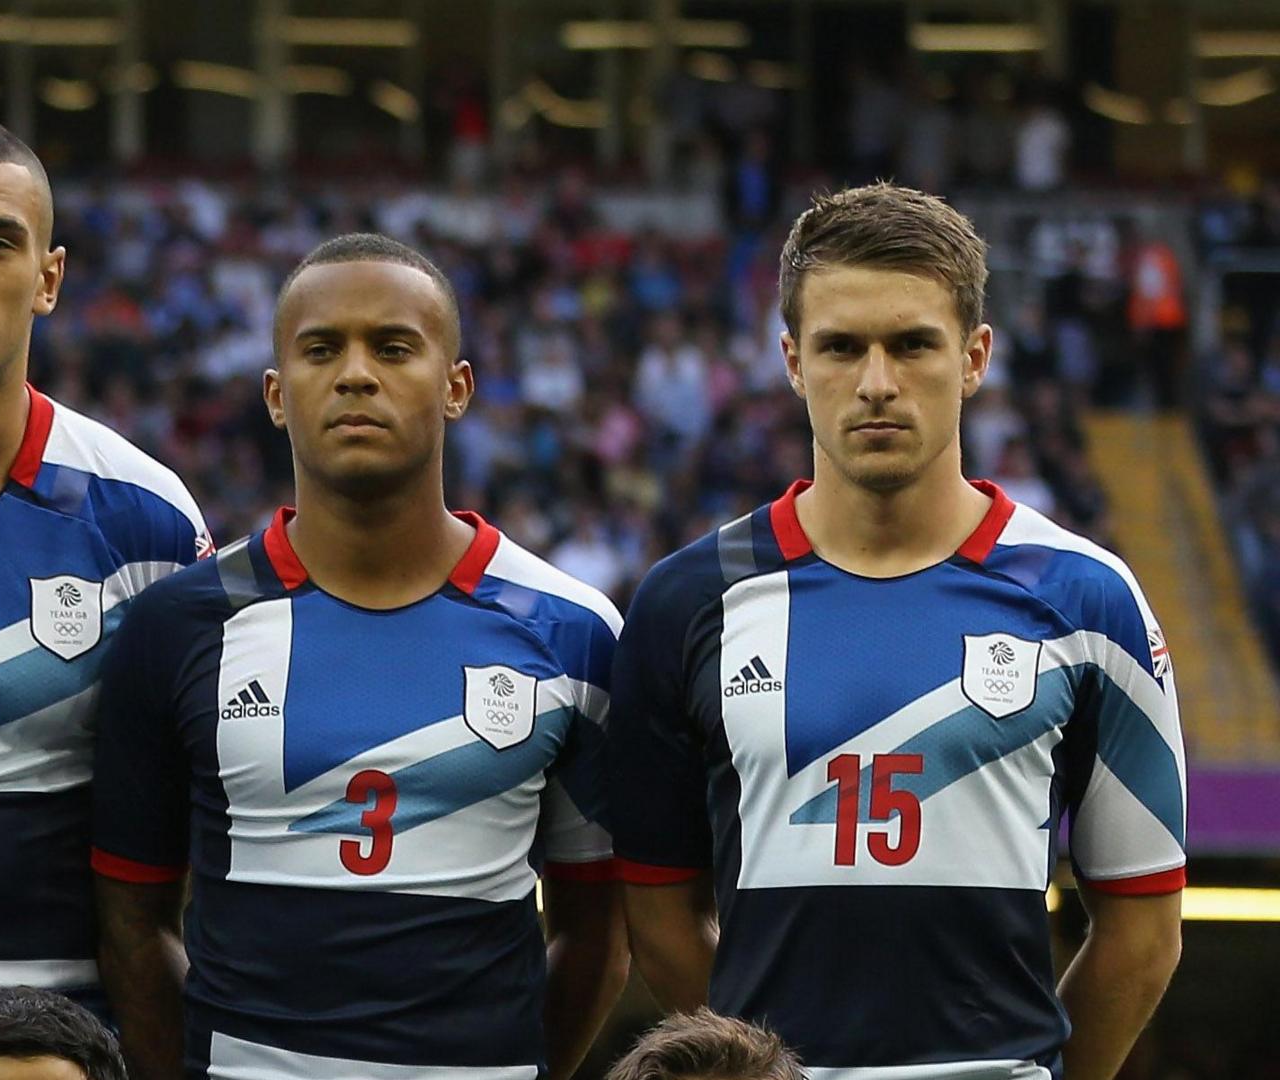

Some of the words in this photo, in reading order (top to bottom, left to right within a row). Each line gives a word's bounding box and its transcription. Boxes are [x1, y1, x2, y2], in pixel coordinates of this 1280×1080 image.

[50, 610, 73, 619] TEAM
[75, 611, 87, 619] GB
[982, 668, 1005, 676] TEAM
[1007, 670, 1019, 678] GB
[724, 680, 782, 697] adidas
[222, 705, 280, 719] adidas
[483, 699, 505, 708] TEAM
[508, 702, 519, 711] GB
[827, 753, 923, 867] 15
[339, 769, 397, 875] 3
